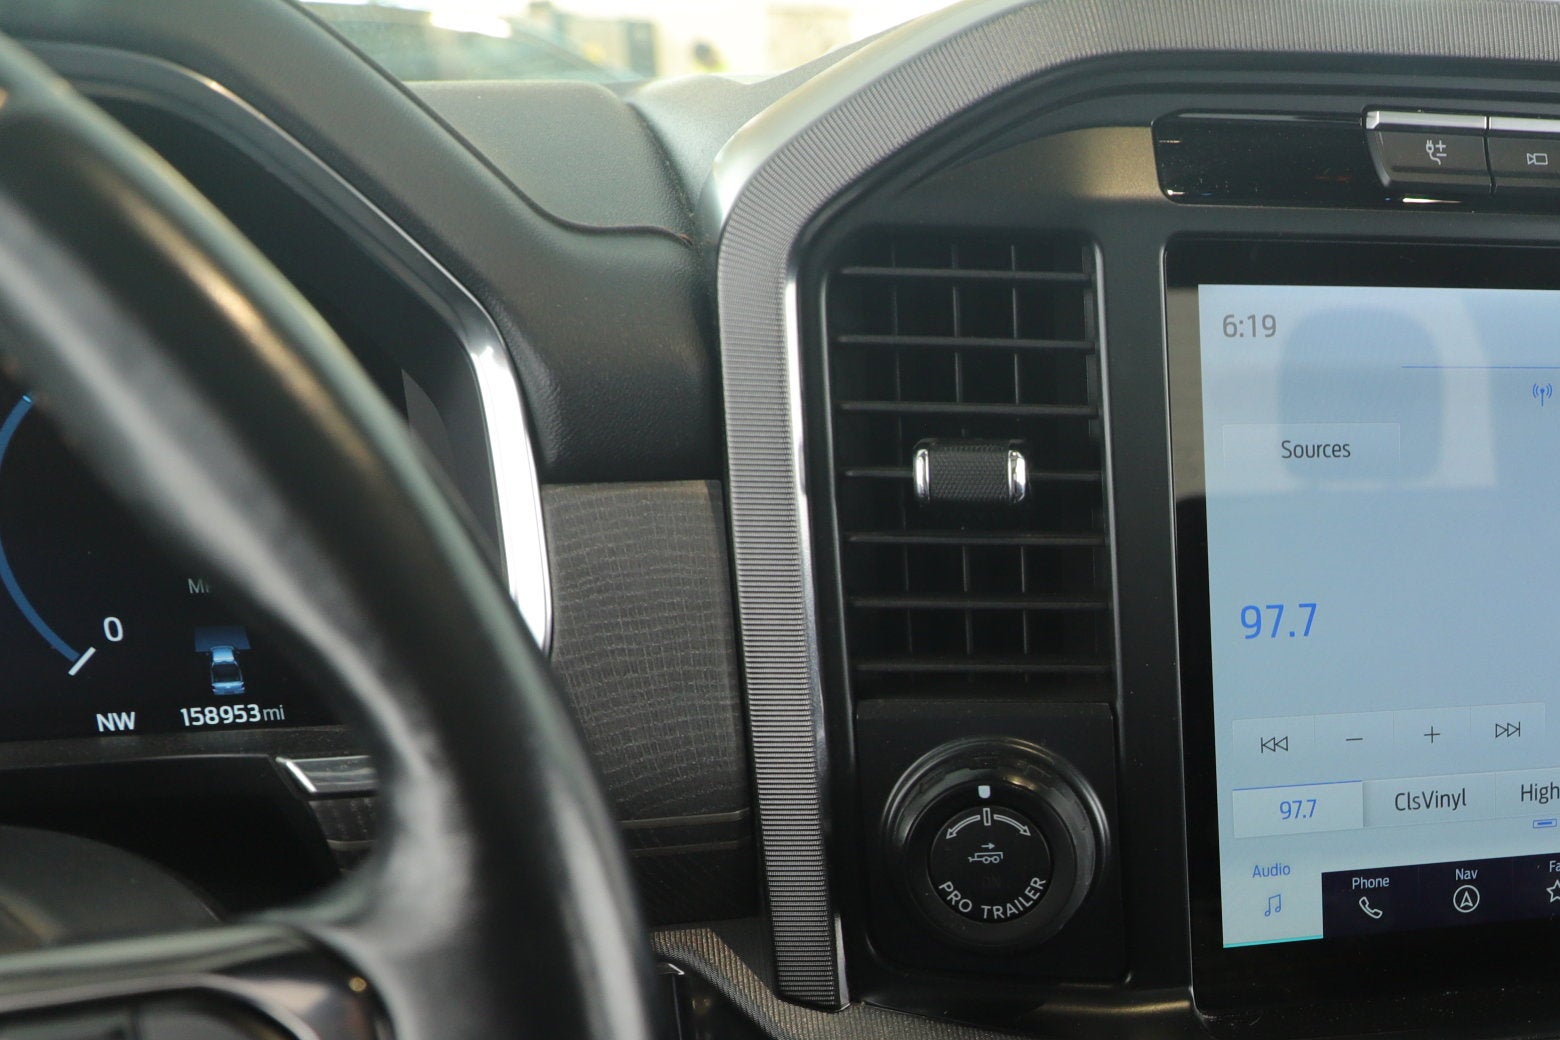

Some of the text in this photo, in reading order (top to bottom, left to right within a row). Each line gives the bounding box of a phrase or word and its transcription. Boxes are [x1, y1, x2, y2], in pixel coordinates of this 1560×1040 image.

[1222, 314, 1277, 338] 6:19
[1281, 440, 1351, 460] Sources
[103, 616, 124, 642] 0
[1240, 603, 1318, 640] 97.7
[96, 711, 136, 732] NW
[1279, 799, 1317, 820] 97.7
[1394, 788, 1467, 812] ClsVinyl
[1252, 861, 1291, 879] Audio
[1455, 867, 1478, 881] Nav
[1352, 875, 1390, 891] Phone
[938, 876, 1047, 920] PRO TRAILER
